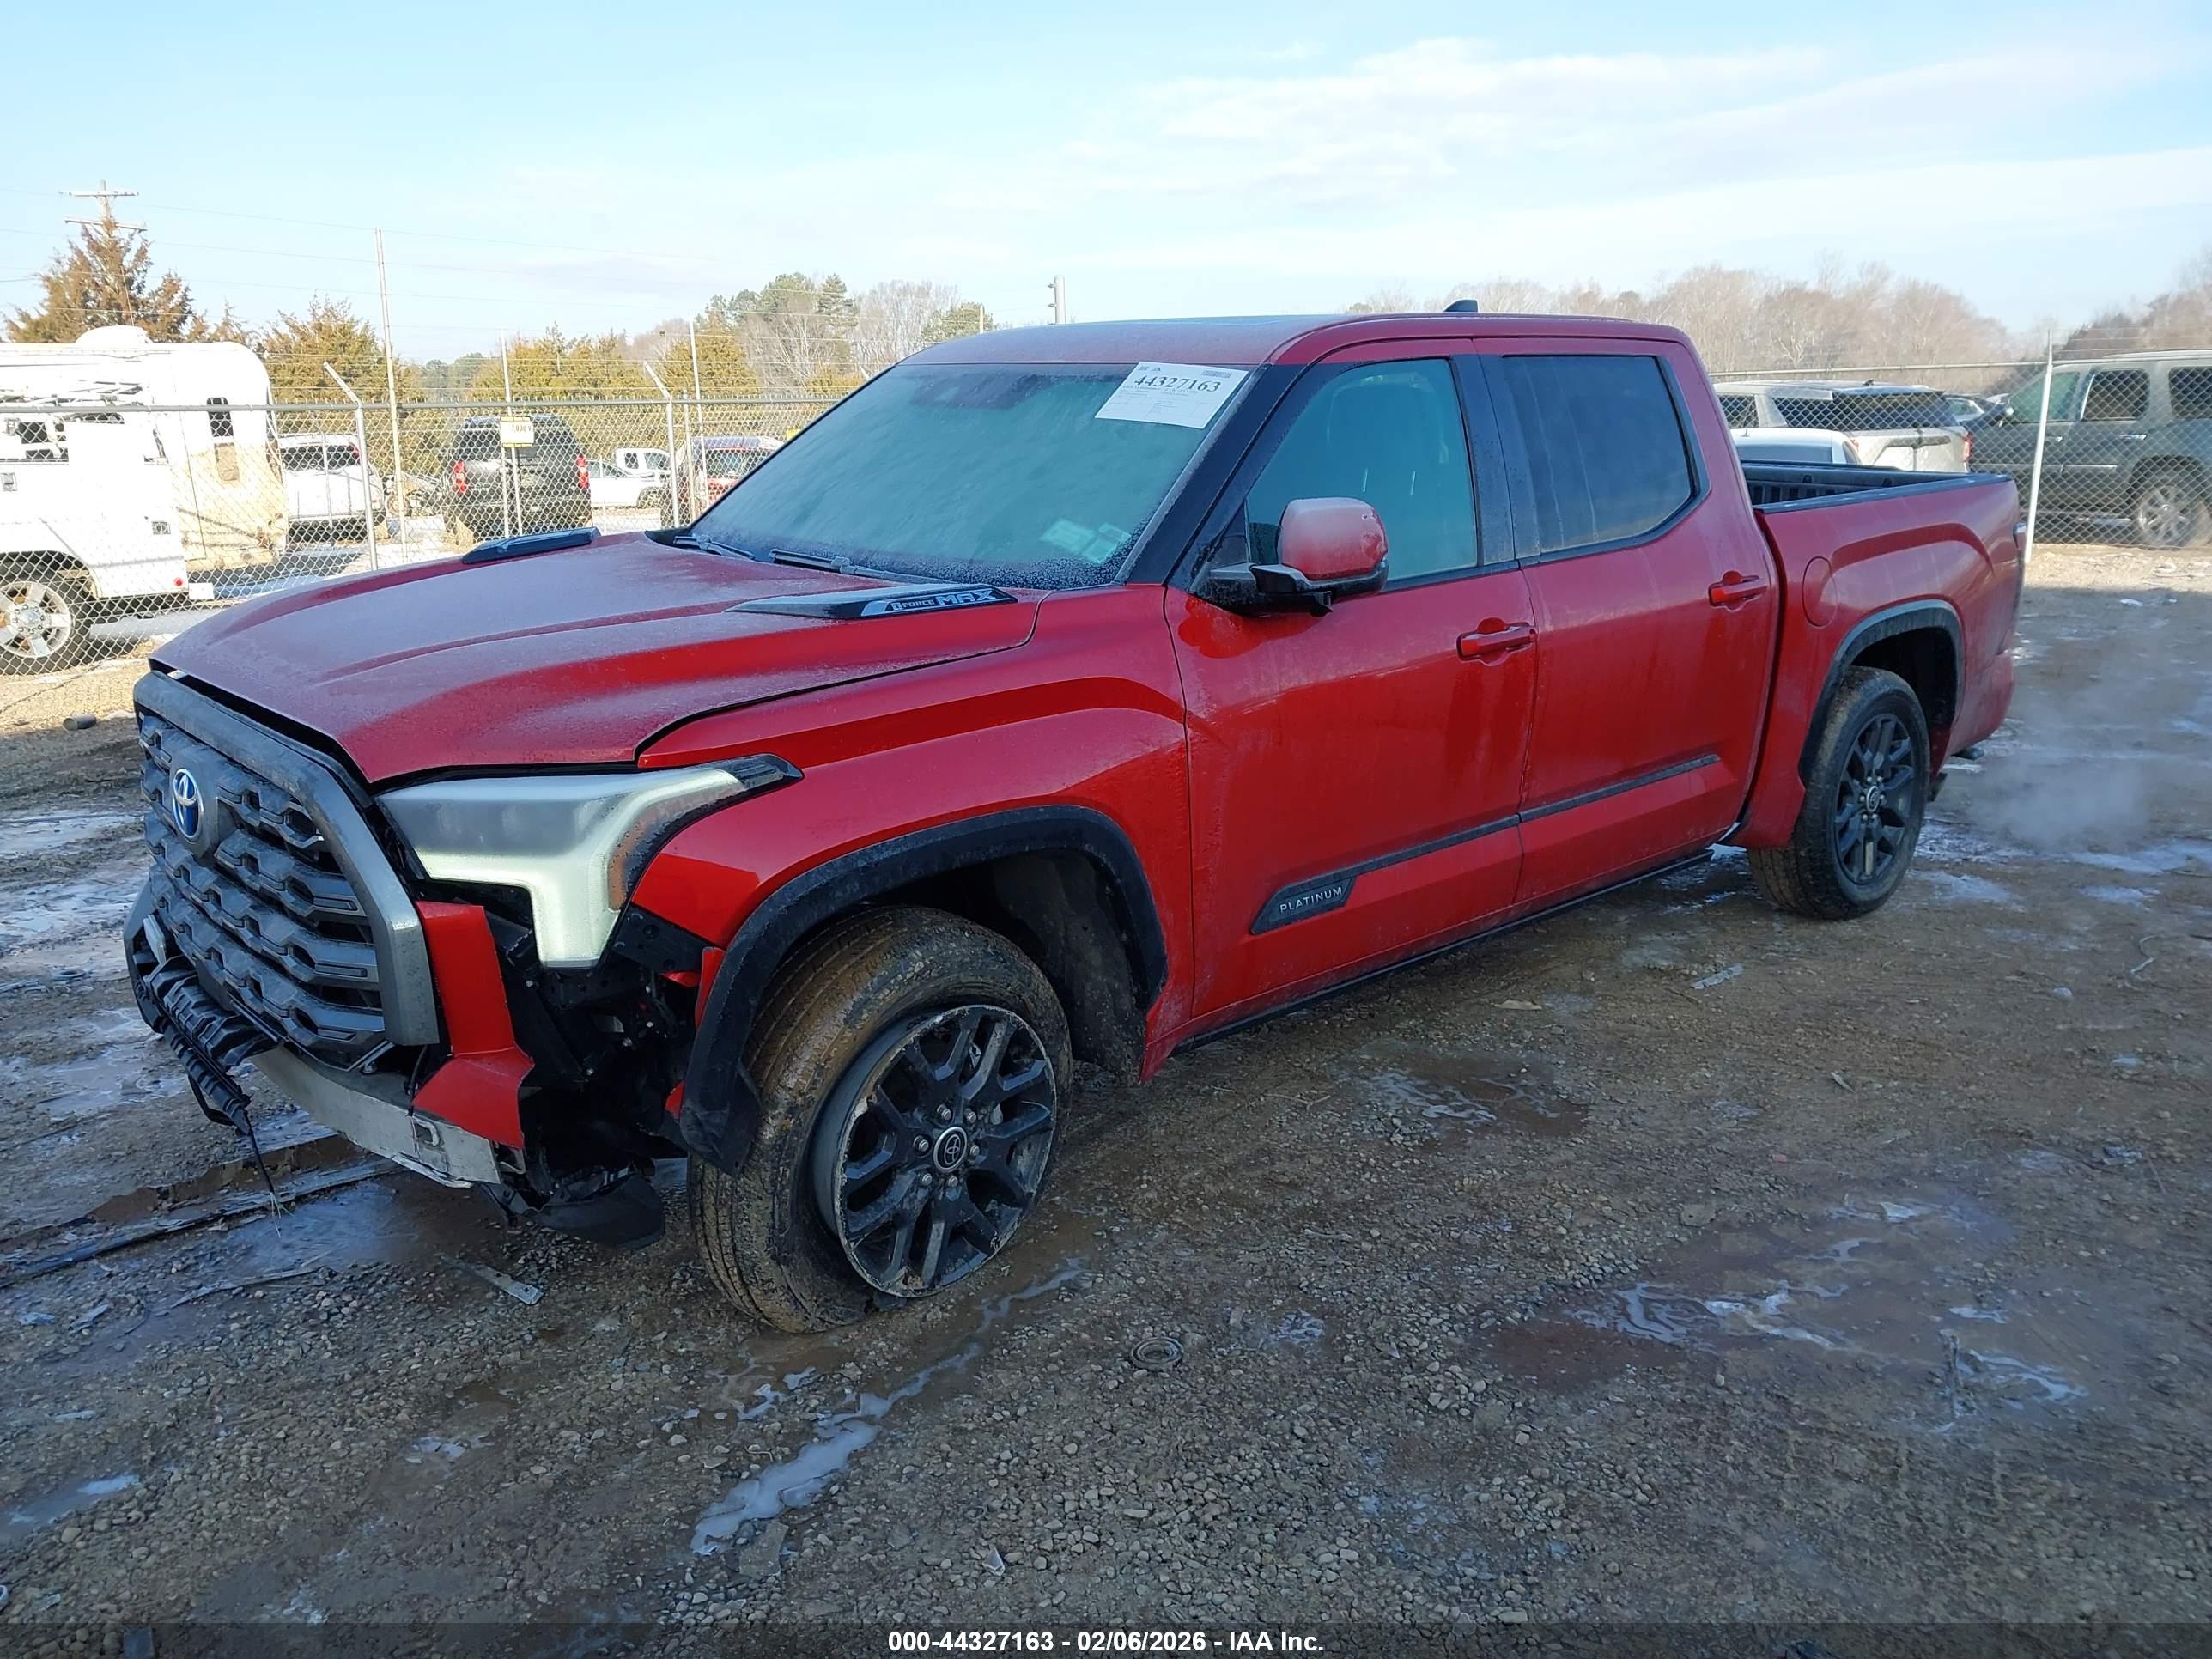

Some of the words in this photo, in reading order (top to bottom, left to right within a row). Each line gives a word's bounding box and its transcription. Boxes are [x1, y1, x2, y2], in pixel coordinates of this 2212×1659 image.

[1133, 374, 1221, 392] 44327163
[935, 590, 997, 605] MAX
[1279, 886, 1343, 913] PLATINUM
